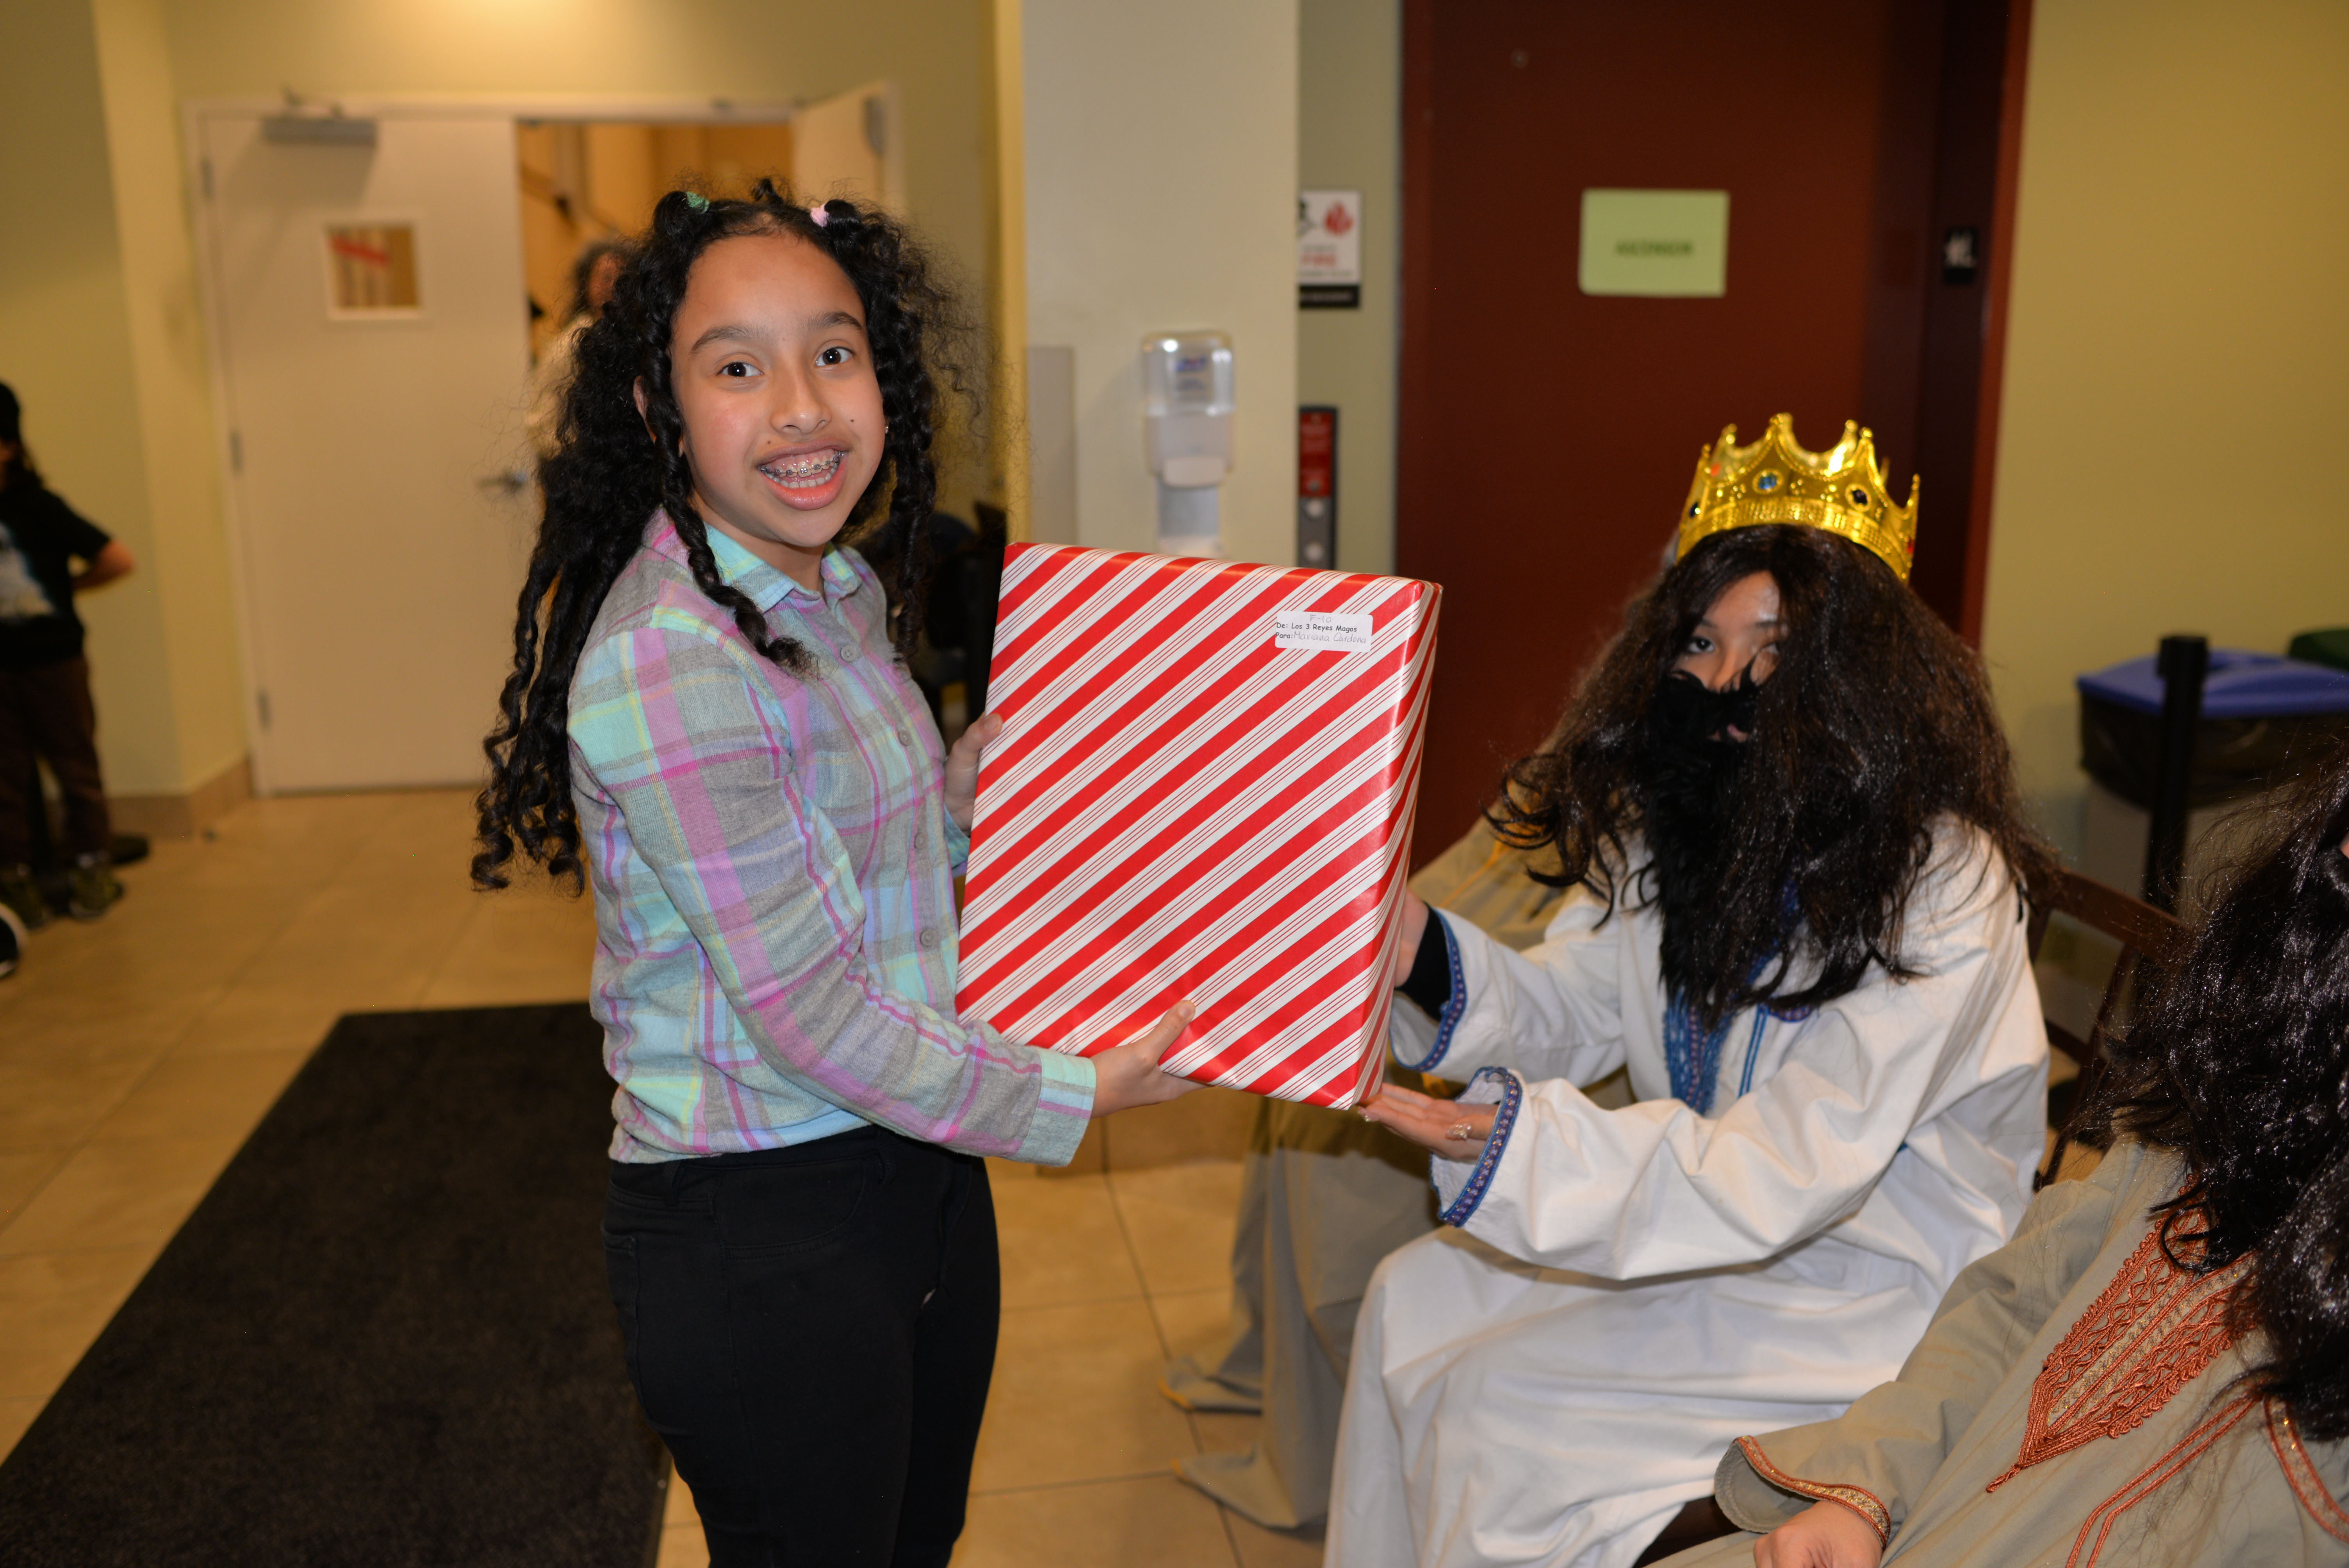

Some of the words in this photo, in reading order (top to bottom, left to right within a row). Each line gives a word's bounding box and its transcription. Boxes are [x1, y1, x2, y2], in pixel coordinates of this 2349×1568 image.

[1313, 624, 1333, 632] Reyes
[1335, 625, 1357, 633] Magos
[1294, 631, 1330, 642] Mariana
[1333, 632, 1366, 644] Cardona
